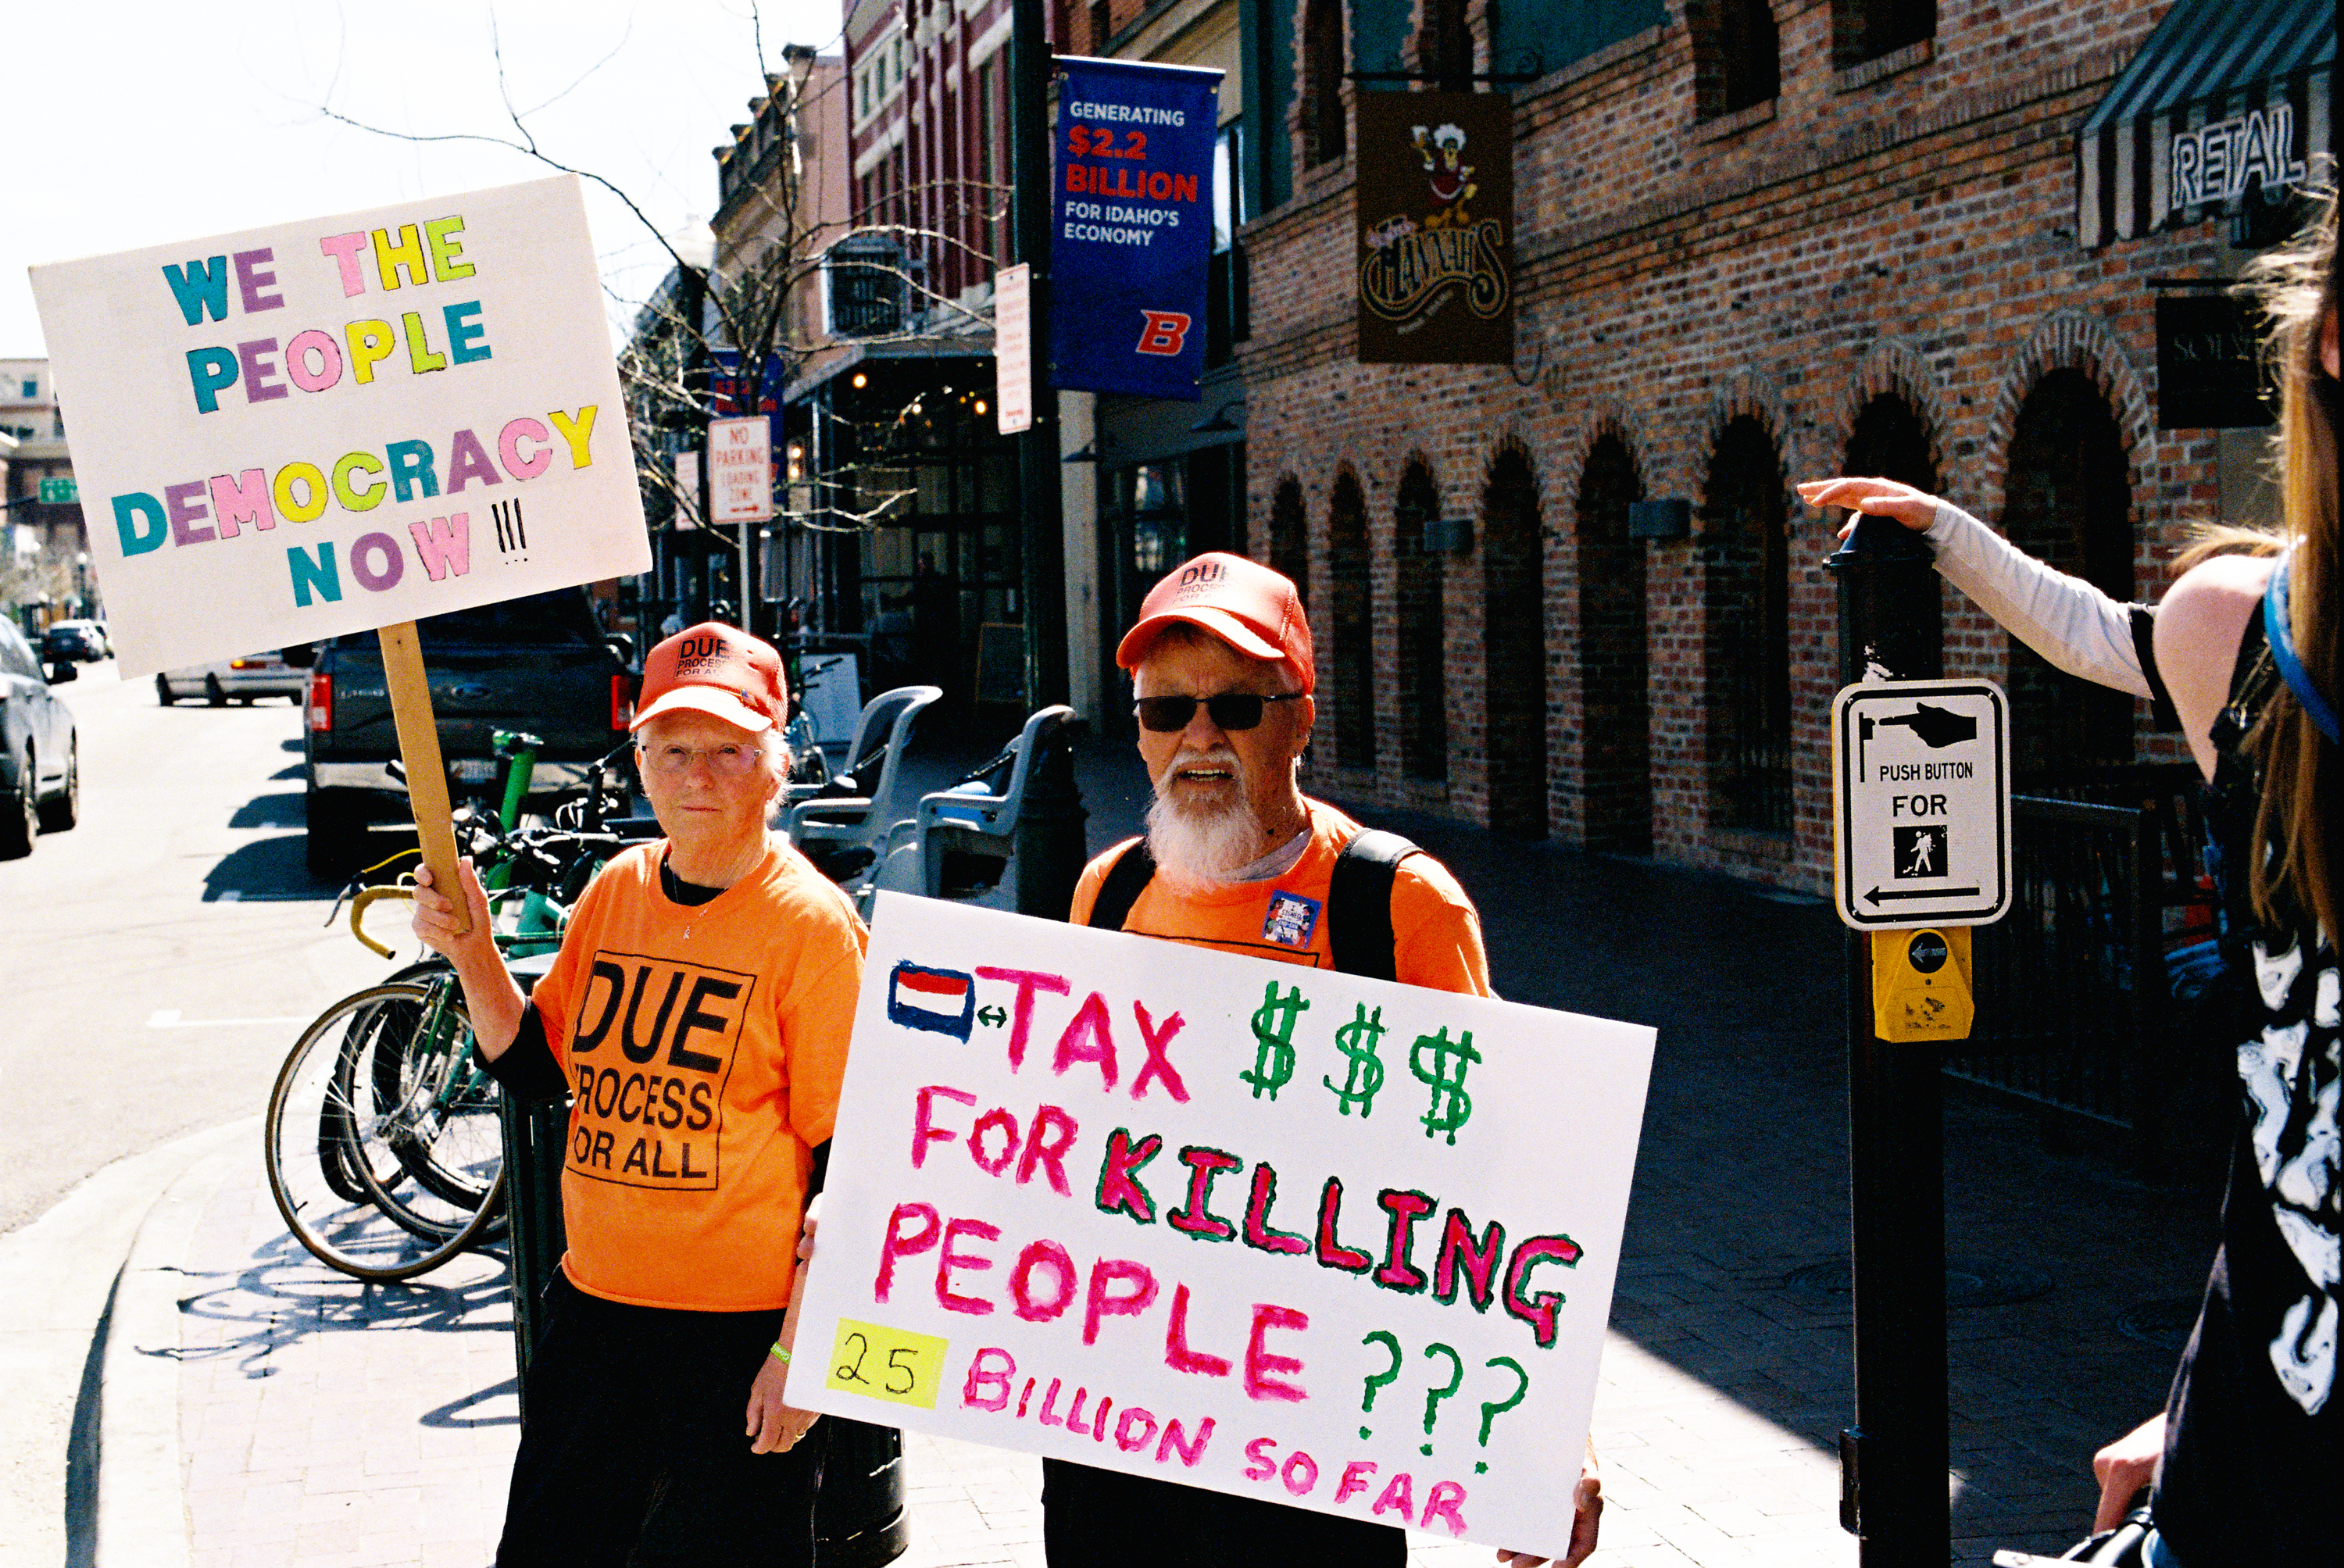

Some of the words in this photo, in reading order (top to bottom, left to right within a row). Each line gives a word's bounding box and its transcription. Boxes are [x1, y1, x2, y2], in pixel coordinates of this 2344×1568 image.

[1070, 101, 1185, 127] GENERATING
[1067, 124, 1147, 160] $2.2
[2171, 103, 2306, 210] RETAIL
[1066, 163, 1198, 203] BILLION
[1064, 223, 1154, 247] ECONOMY
[1065, 201, 1102, 220] FOR
[1106, 205, 1180, 227] IDAHO'S
[162, 247, 286, 327] WE
[320, 215, 477, 298] THE
[1135, 310, 1192, 356] B
[185, 300, 492, 415] PEOPLE
[716, 447, 764, 466] PARKING
[730, 427, 749, 445] NO
[110, 405, 599, 558] DEMOCRACY
[286, 512, 470, 608] NOW
[680, 638, 731, 659] DUE
[675, 668, 700, 677] FOR
[1880, 764, 1921, 782] PUSH
[1924, 761, 1974, 780] BUTTON
[1892, 794, 1948, 817] FOR
[571, 960, 743, 1074] DUE
[975, 965, 1192, 1105] TAX
[574, 1063, 713, 1131] ROCESS
[622, 1138, 708, 1178] ALL
[911, 1084, 1079, 1198] FOR
[1096, 1127, 1585, 1350] KILLING
[874, 1201, 1310, 1403] PEOPLE
[836, 1332, 919, 1395] 25
[959, 1346, 1217, 1468] BILLION
[1241, 1437, 1320, 1497] SO
[1334, 1459, 1469, 1538] FAR
